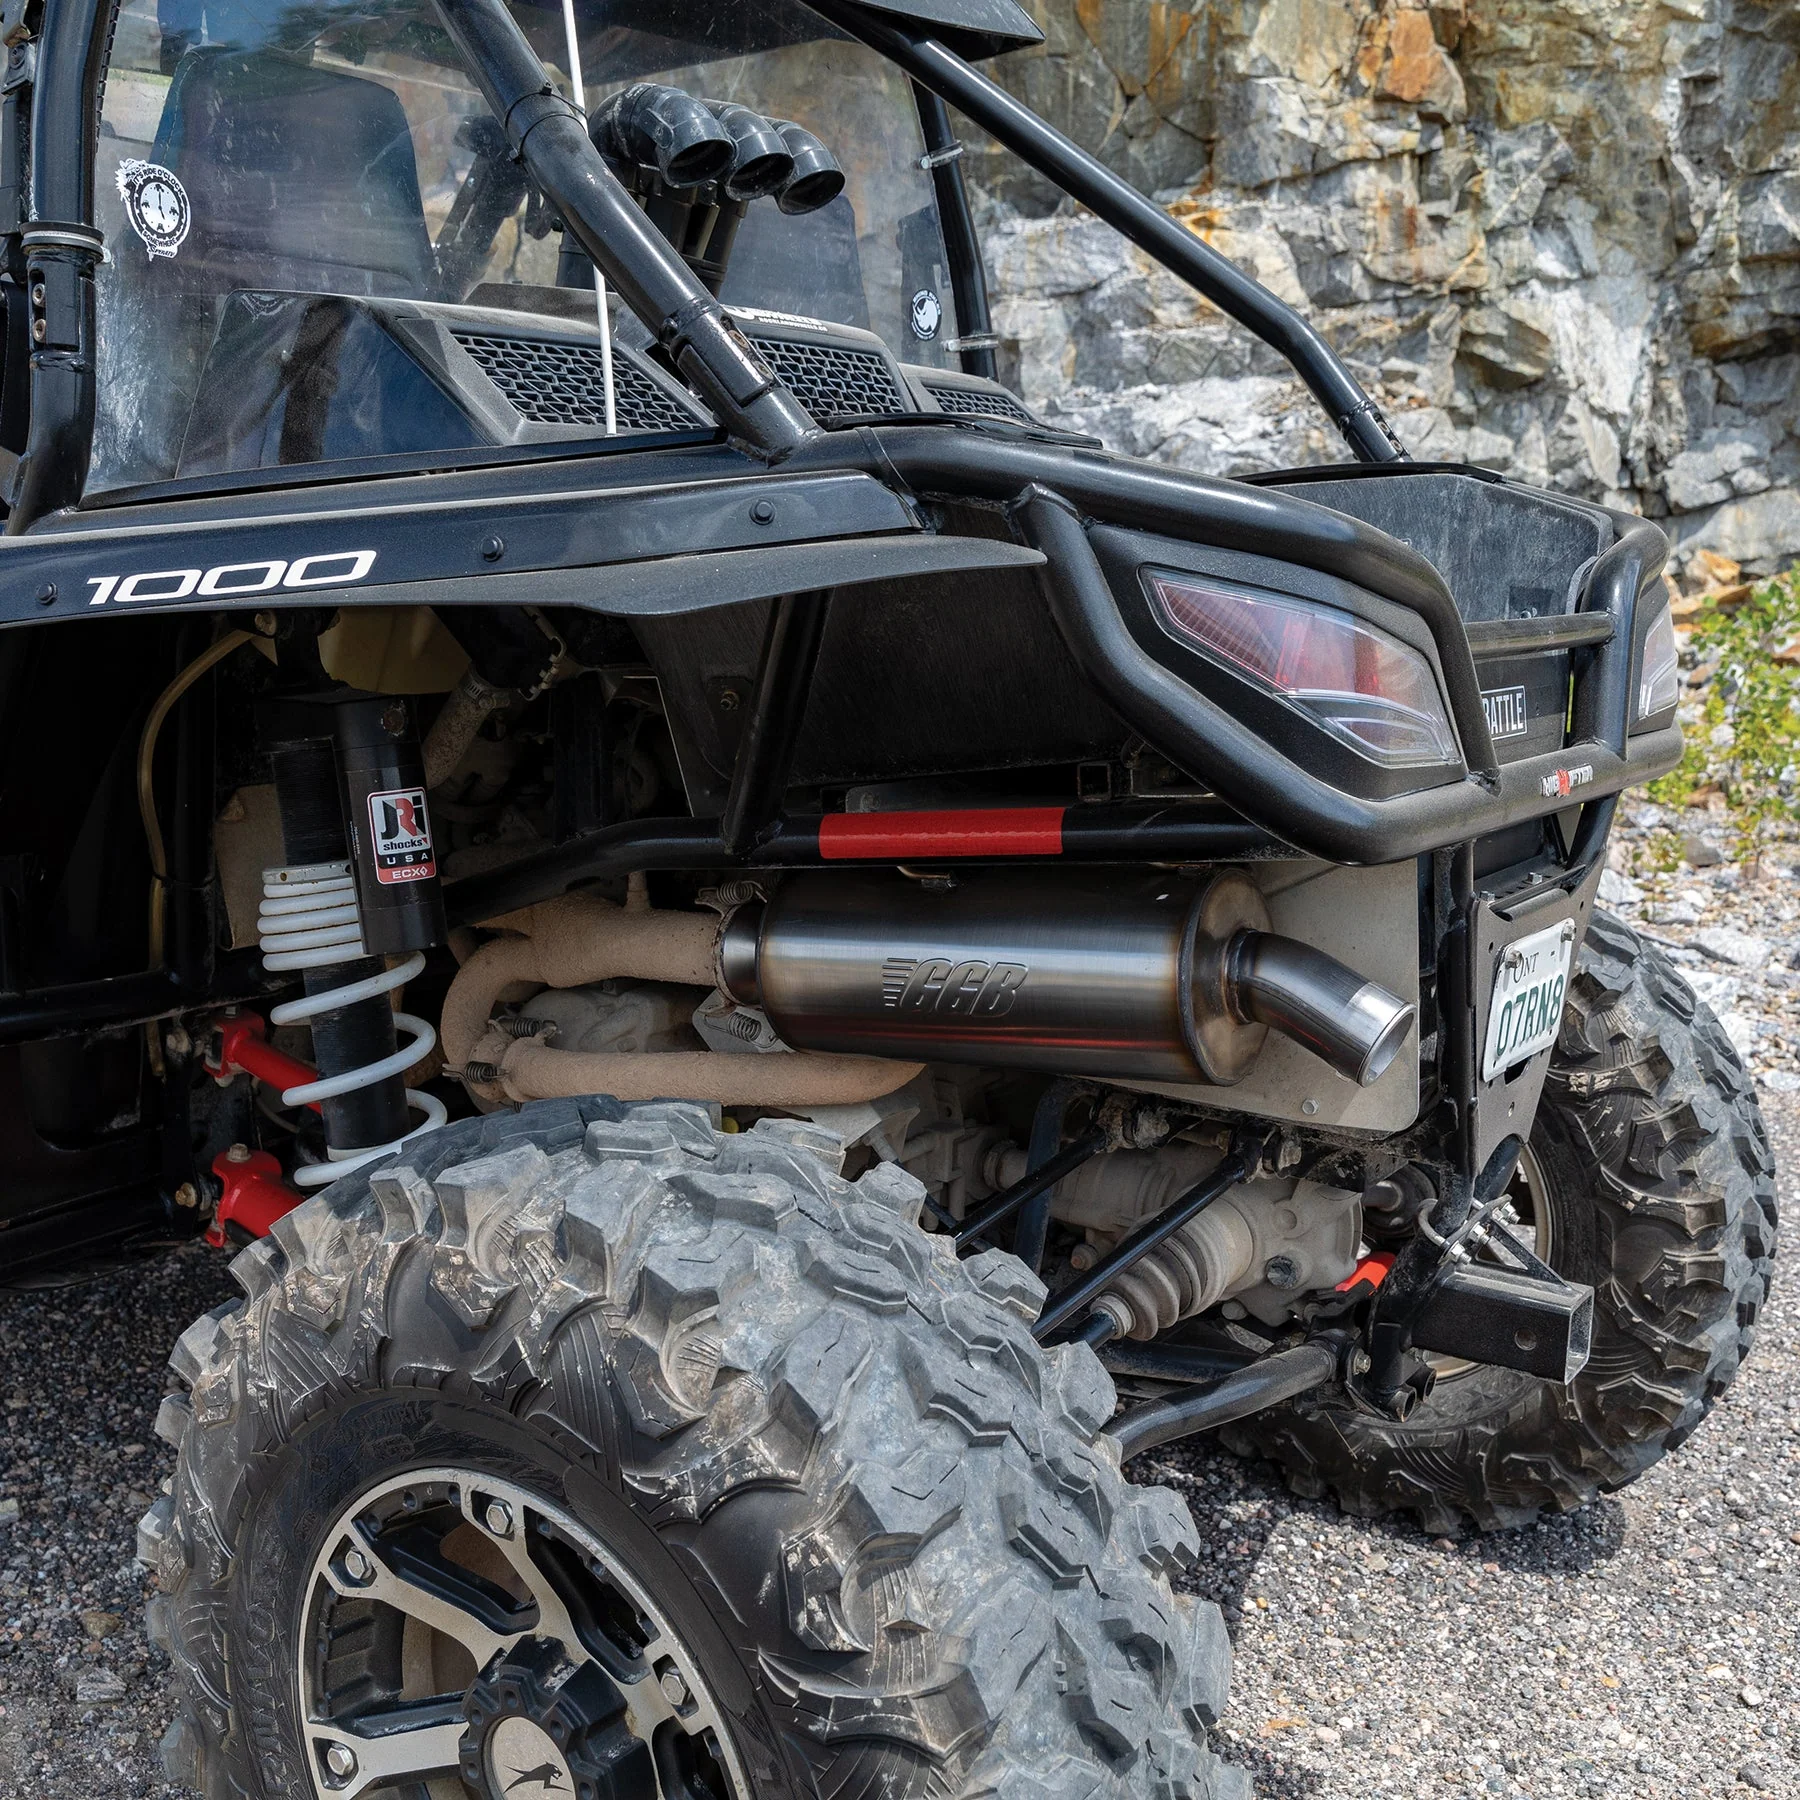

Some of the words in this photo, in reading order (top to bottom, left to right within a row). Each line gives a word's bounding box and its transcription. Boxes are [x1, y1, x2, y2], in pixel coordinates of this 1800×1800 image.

[143, 167, 157, 176] RIDE
[157, 169, 184, 195] O'CLOCK
[142, 230, 179, 247] SOMEWHERE
[86, 549, 378, 606] 1000
[383, 838, 423, 851] shocks
[1496, 973, 1564, 1057] 07RN8
